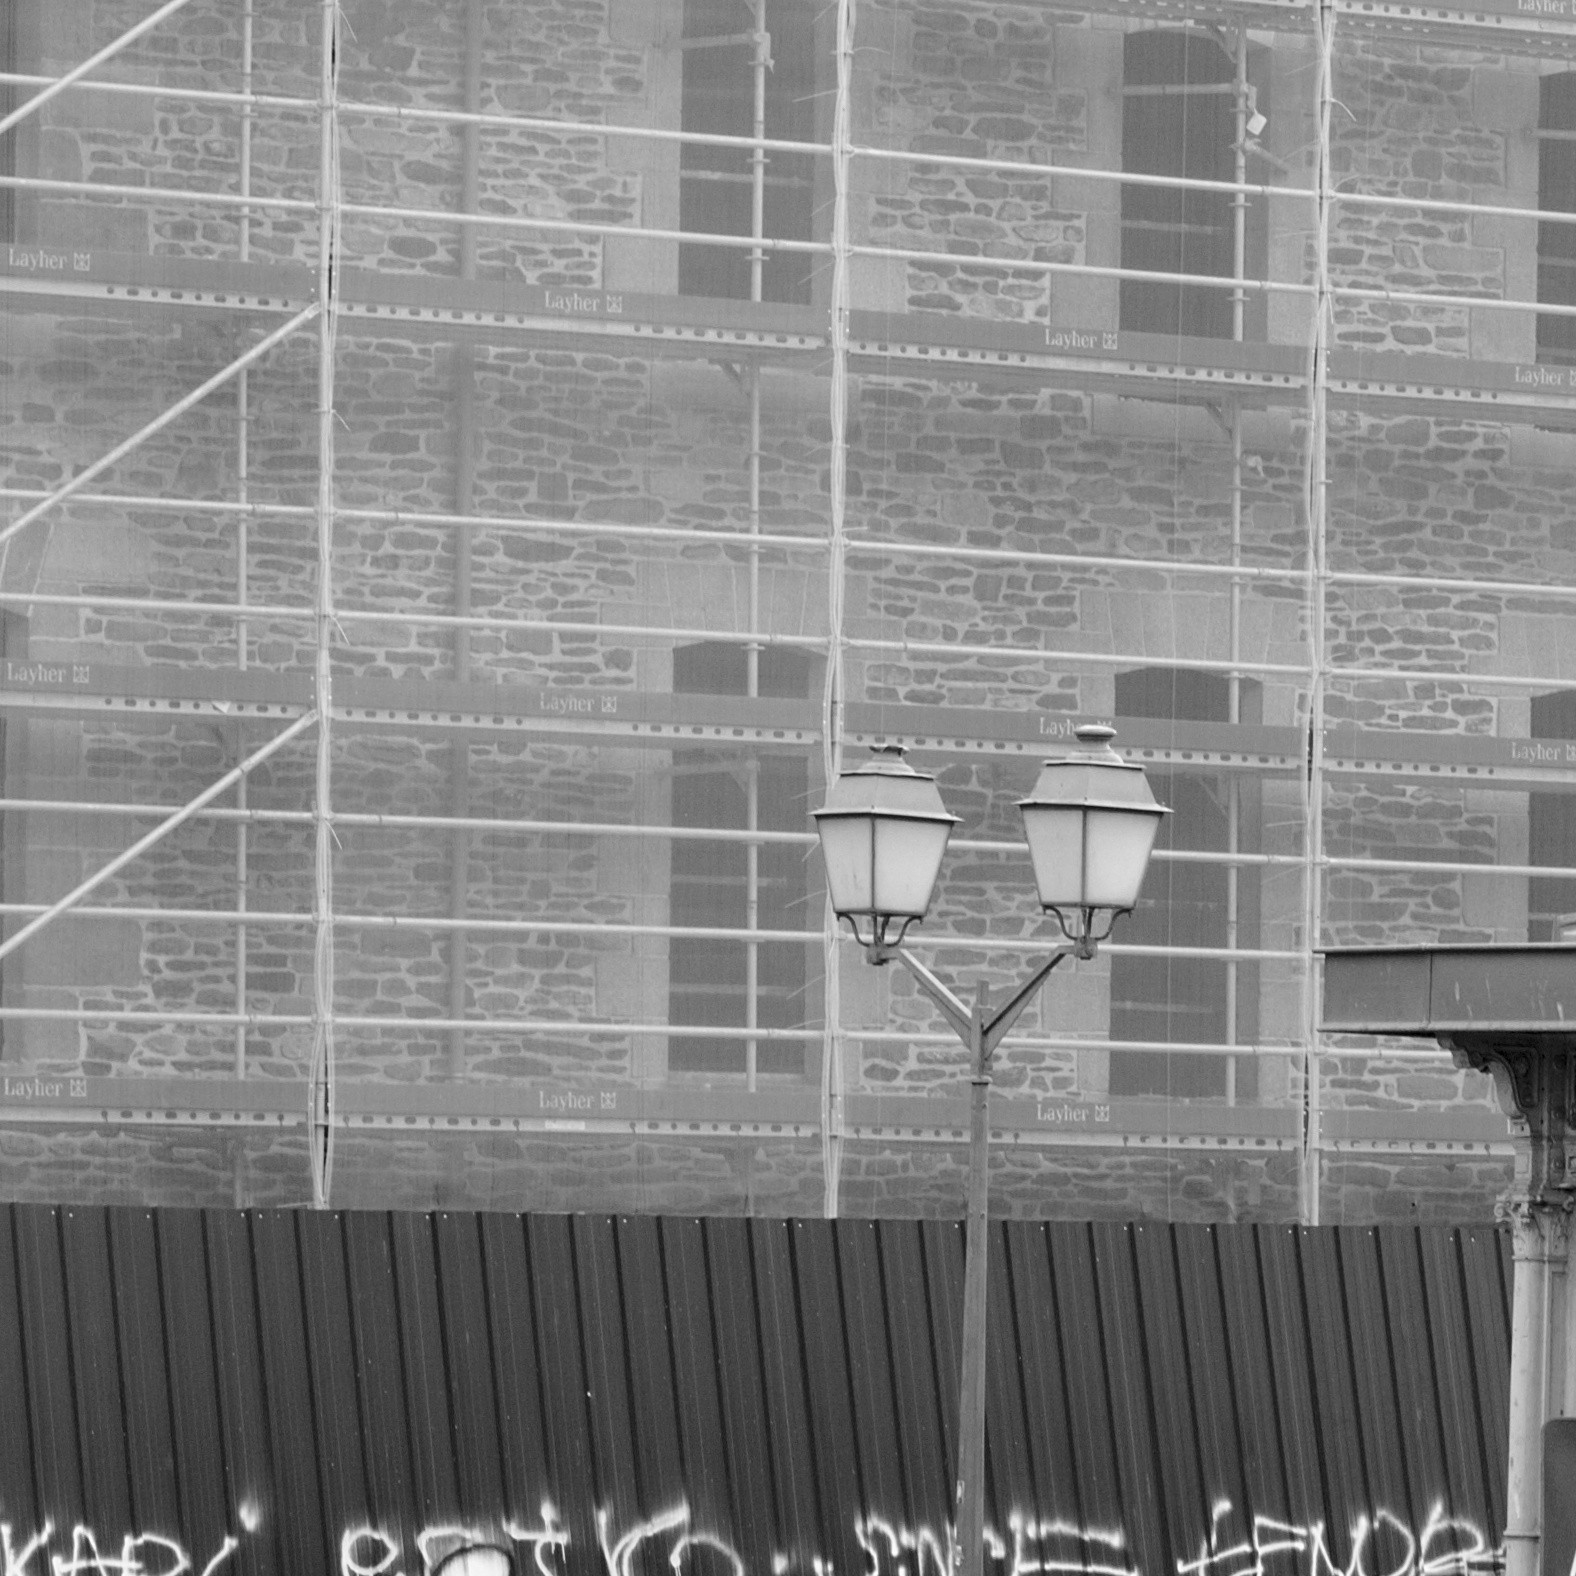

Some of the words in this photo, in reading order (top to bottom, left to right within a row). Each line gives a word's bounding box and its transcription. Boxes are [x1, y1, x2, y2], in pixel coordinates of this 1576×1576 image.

[8, 248, 68, 270] Layher
[545, 291, 600, 312] Layher
[1045, 330, 1097, 349] Layher
[1515, 366, 1562, 386] Layher
[7, 662, 67, 686] Layher
[539, 692, 594, 714] Layher
[1512, 742, 1560, 763] Layher
[4, 1078, 64, 1099] Layher
[539, 1091, 595, 1112] Layher
[1037, 1104, 1089, 1123] Layher
